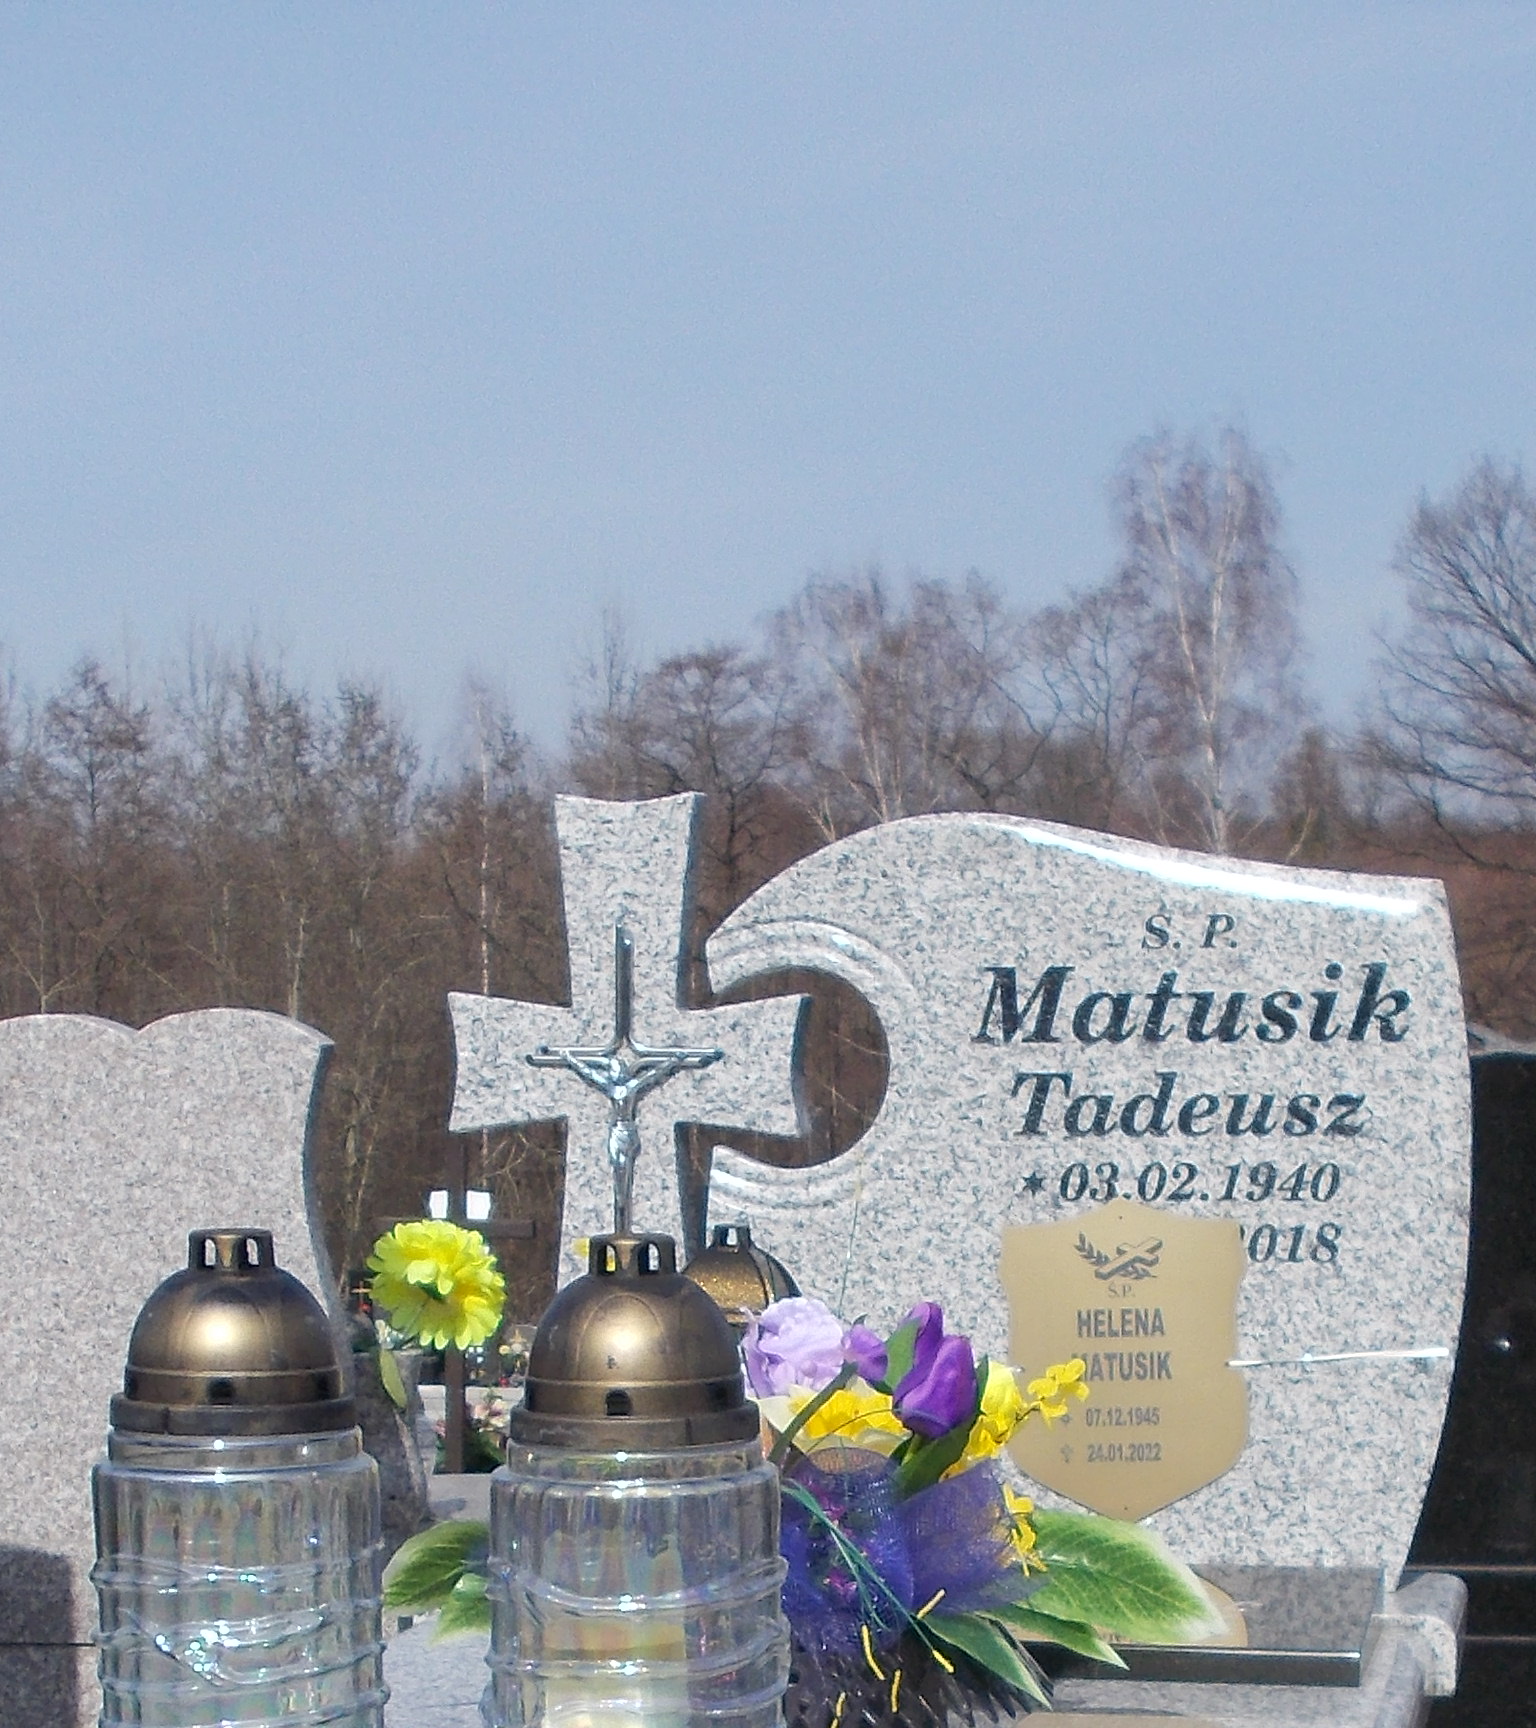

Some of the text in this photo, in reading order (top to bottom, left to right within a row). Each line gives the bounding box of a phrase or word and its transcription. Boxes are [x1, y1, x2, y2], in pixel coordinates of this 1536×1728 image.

[970, 961, 1412, 1045] Matusik
[1011, 1070, 1369, 1138] Tadeusz
[1060, 1161, 1341, 1202] 03.02.1940
[1239, 1221, 1343, 1264] 018
[1077, 1307, 1166, 1338] HELENA
